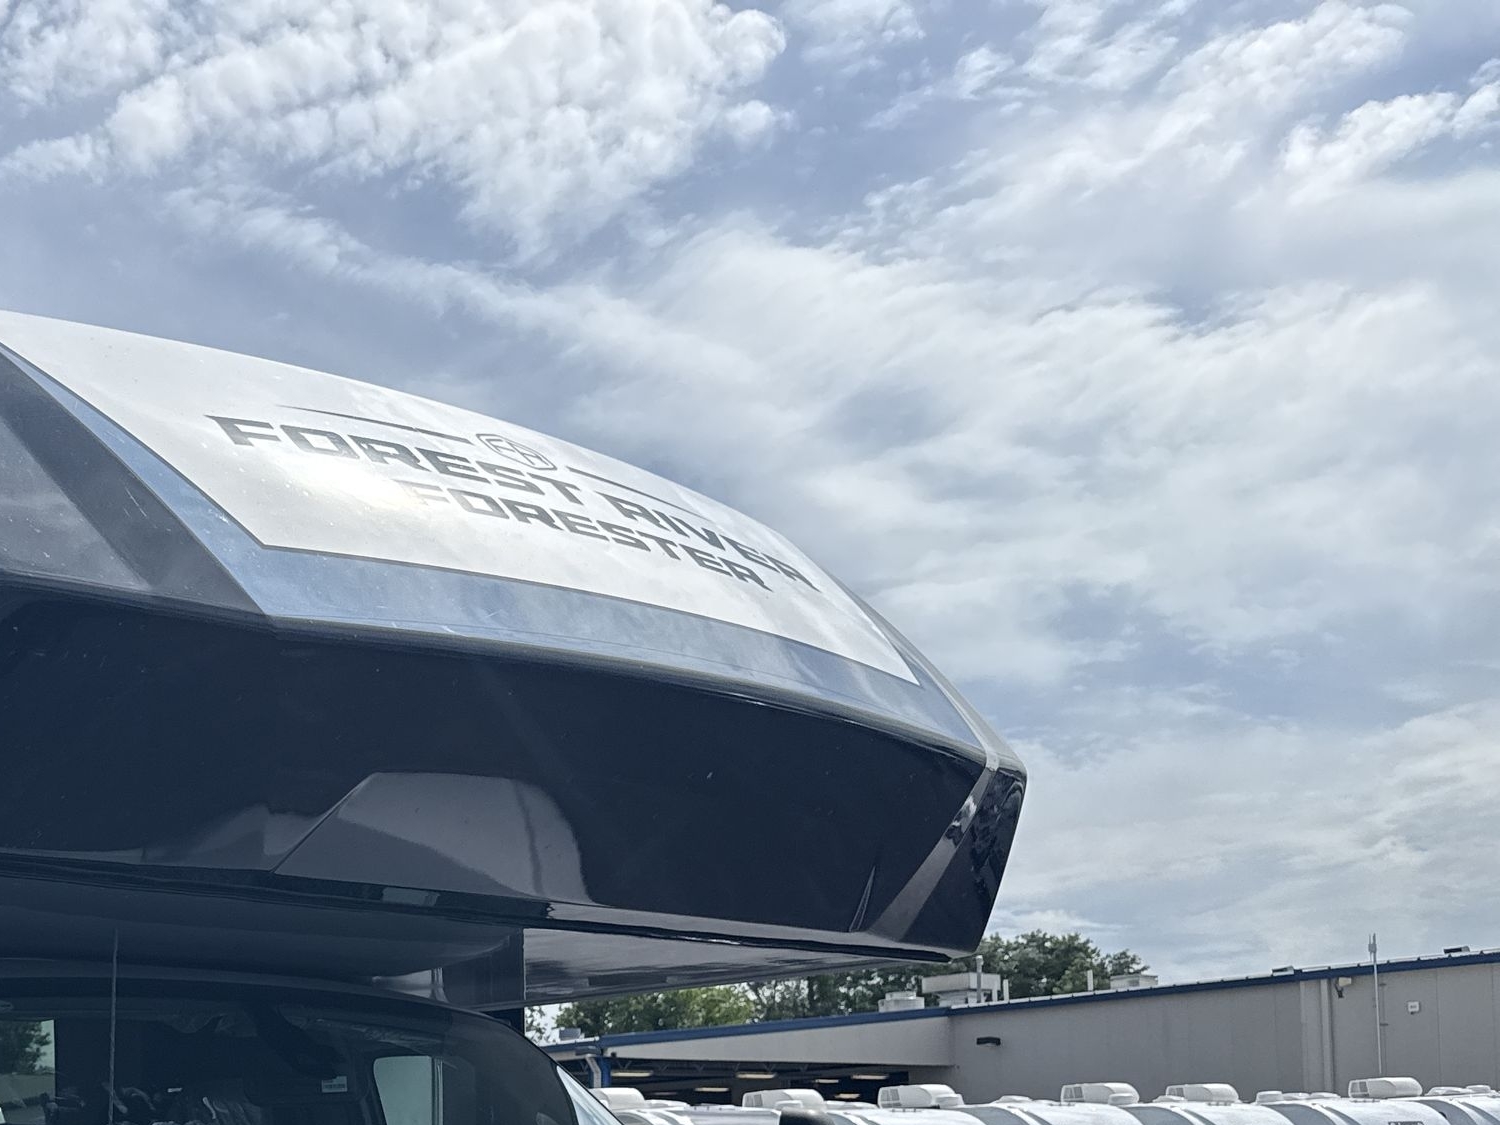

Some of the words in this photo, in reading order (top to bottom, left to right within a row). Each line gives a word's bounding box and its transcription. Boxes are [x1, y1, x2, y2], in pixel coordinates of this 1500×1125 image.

[202, 413, 586, 506] FOREST
[594, 490, 822, 593] RIVER
[392, 478, 775, 593] FORESTER
